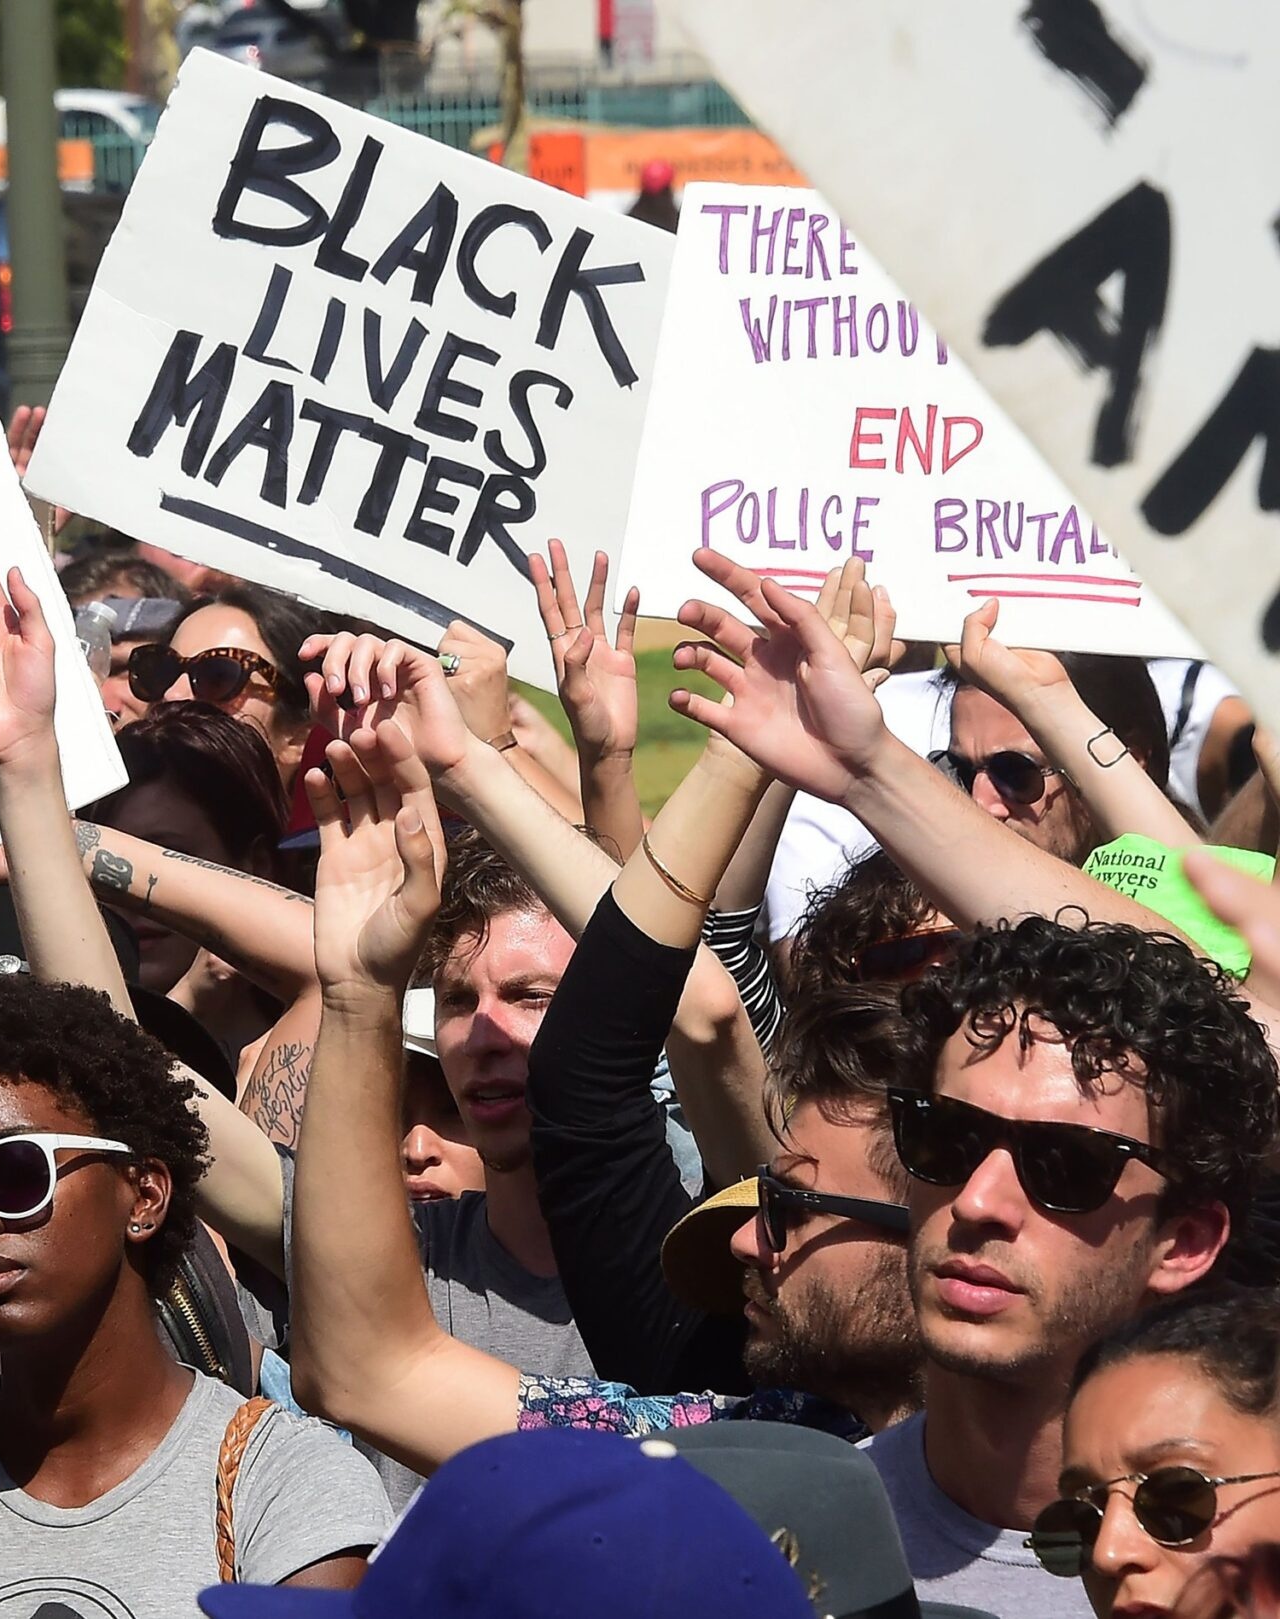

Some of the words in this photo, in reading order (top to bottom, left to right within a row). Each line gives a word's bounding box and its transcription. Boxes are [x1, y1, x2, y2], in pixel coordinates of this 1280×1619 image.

[211, 94, 646, 391] BLACK
[700, 203, 859, 282] THERE
[242, 263, 575, 480] LIVES
[126, 329, 539, 588] MATTER
[848, 403, 984, 476] END
[701, 478, 881, 563] POLICE
[1088, 849, 1167, 872] National
